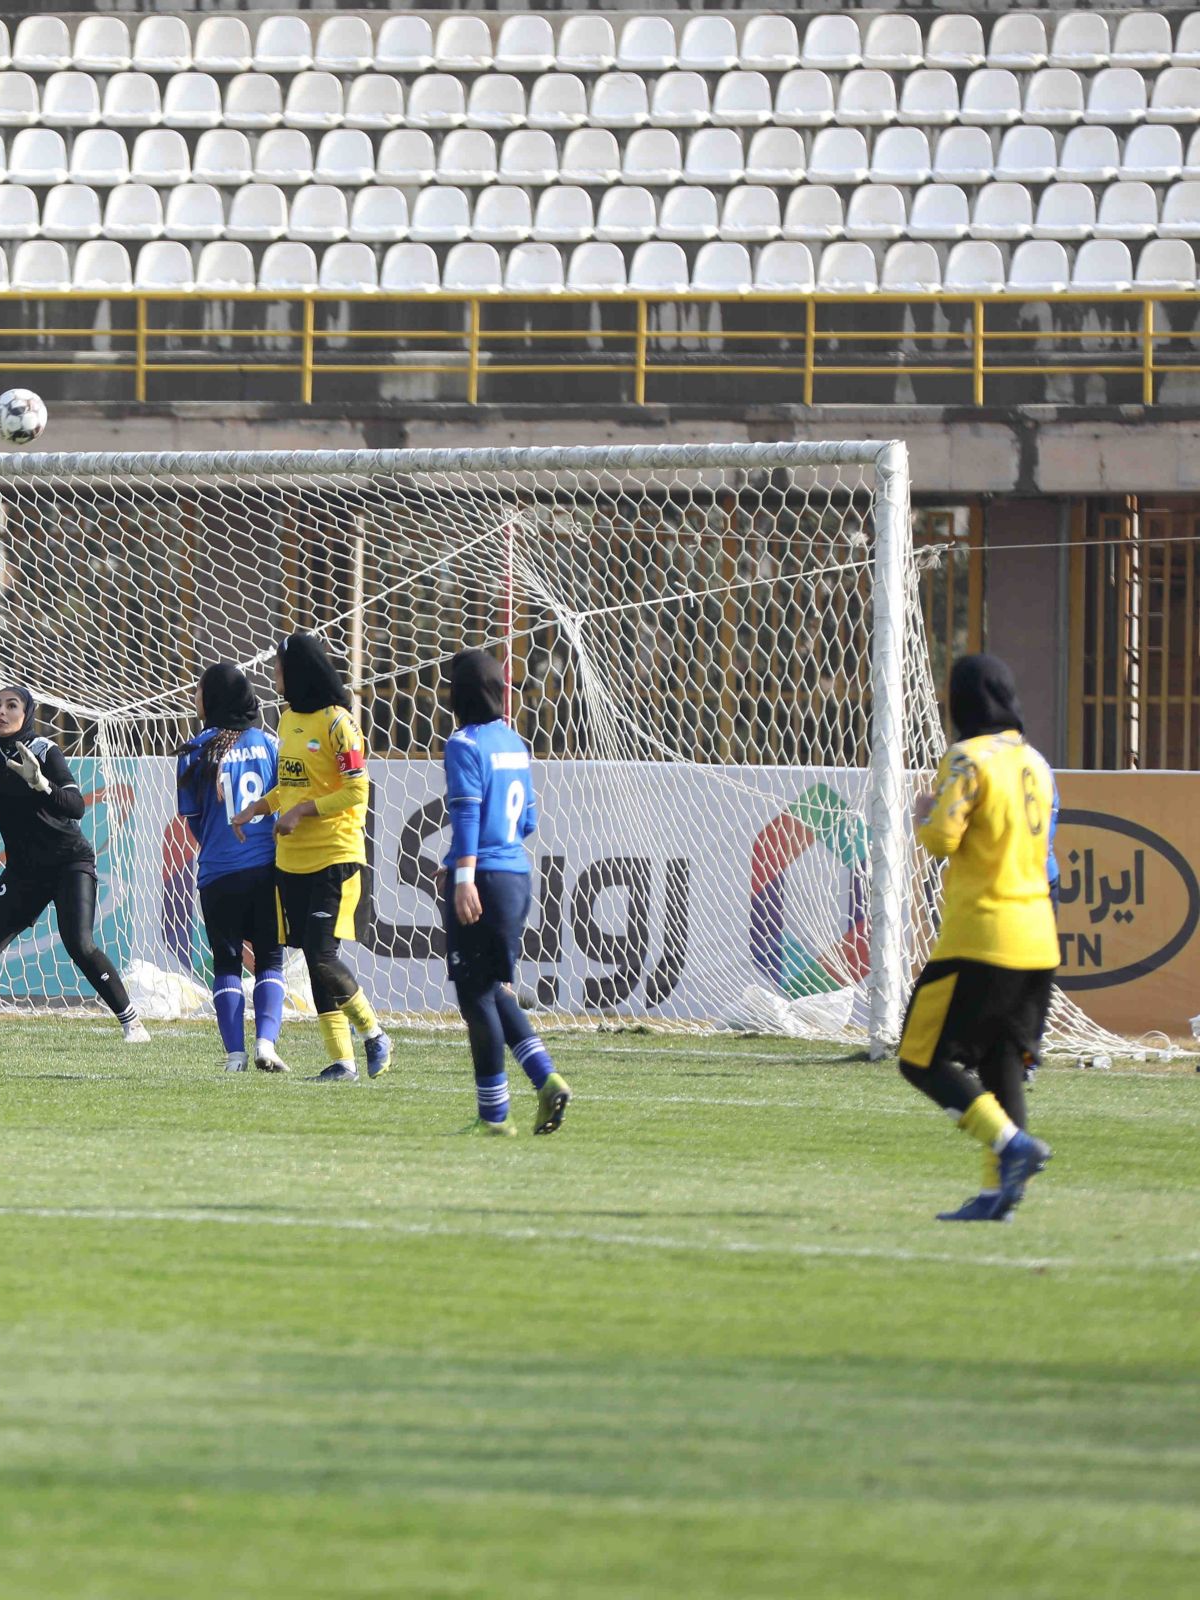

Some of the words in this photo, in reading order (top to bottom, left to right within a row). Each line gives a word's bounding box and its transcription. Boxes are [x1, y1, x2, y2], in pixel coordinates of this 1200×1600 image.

[220, 771, 264, 827] 18
[506, 780, 525, 843] 9
[1057, 933, 1102, 967] TN
